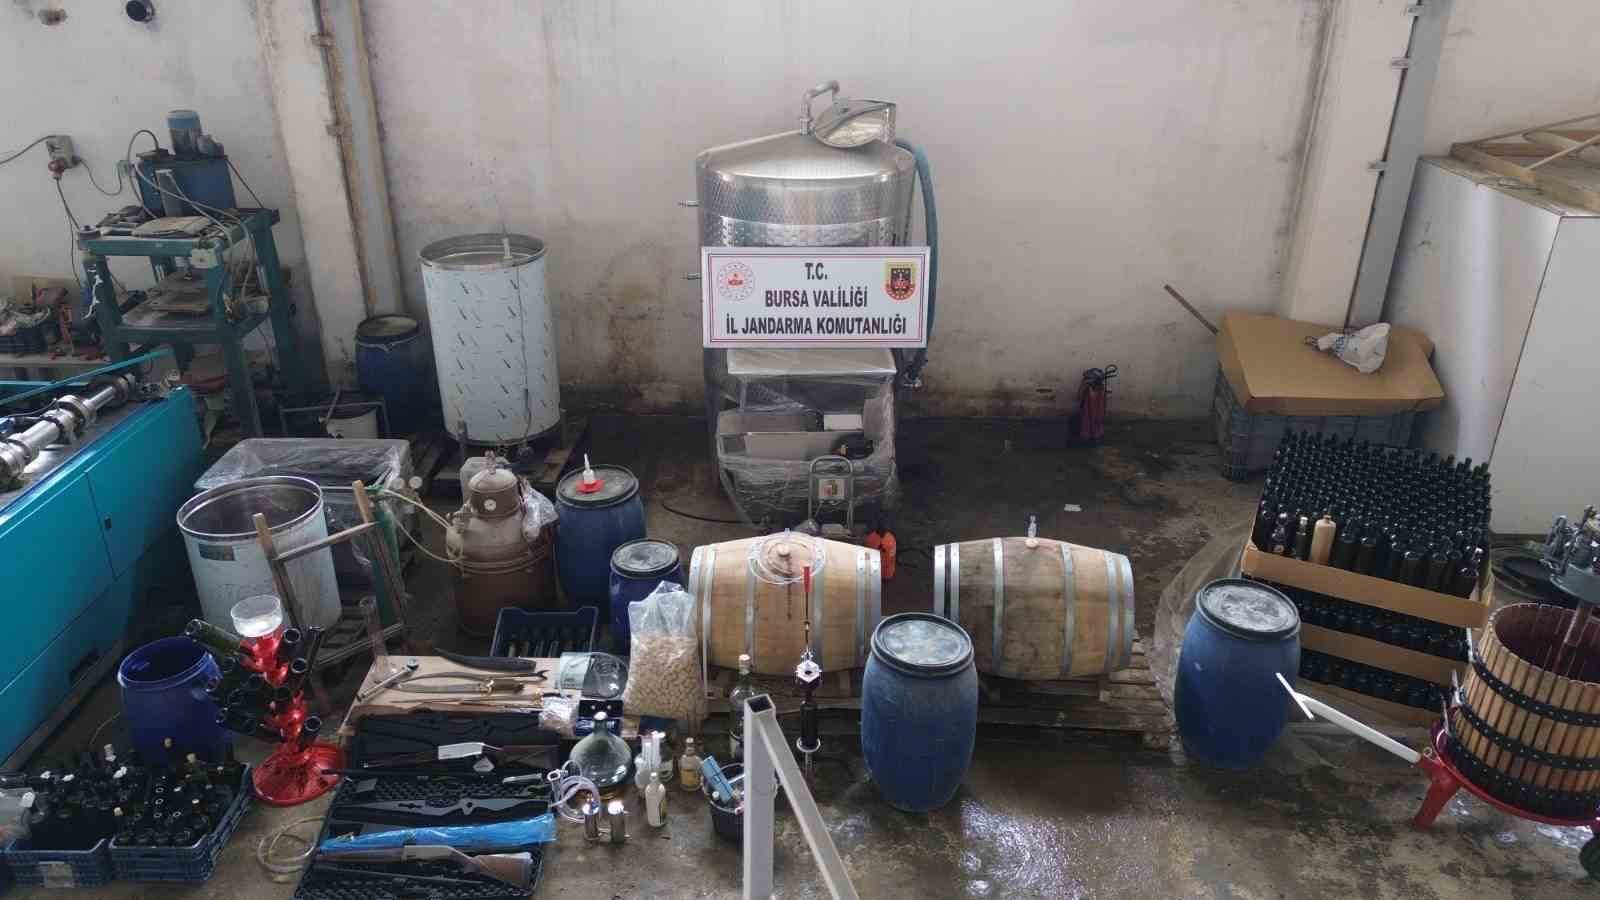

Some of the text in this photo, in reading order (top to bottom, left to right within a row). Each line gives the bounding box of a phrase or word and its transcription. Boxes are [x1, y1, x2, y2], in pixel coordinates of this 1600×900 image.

[805, 262, 828, 280] T.C.
[765, 286, 868, 308] BURSA VALİLİĞİ
[726, 313, 906, 334] İL JANDARMA KOMUTANLIĞI
